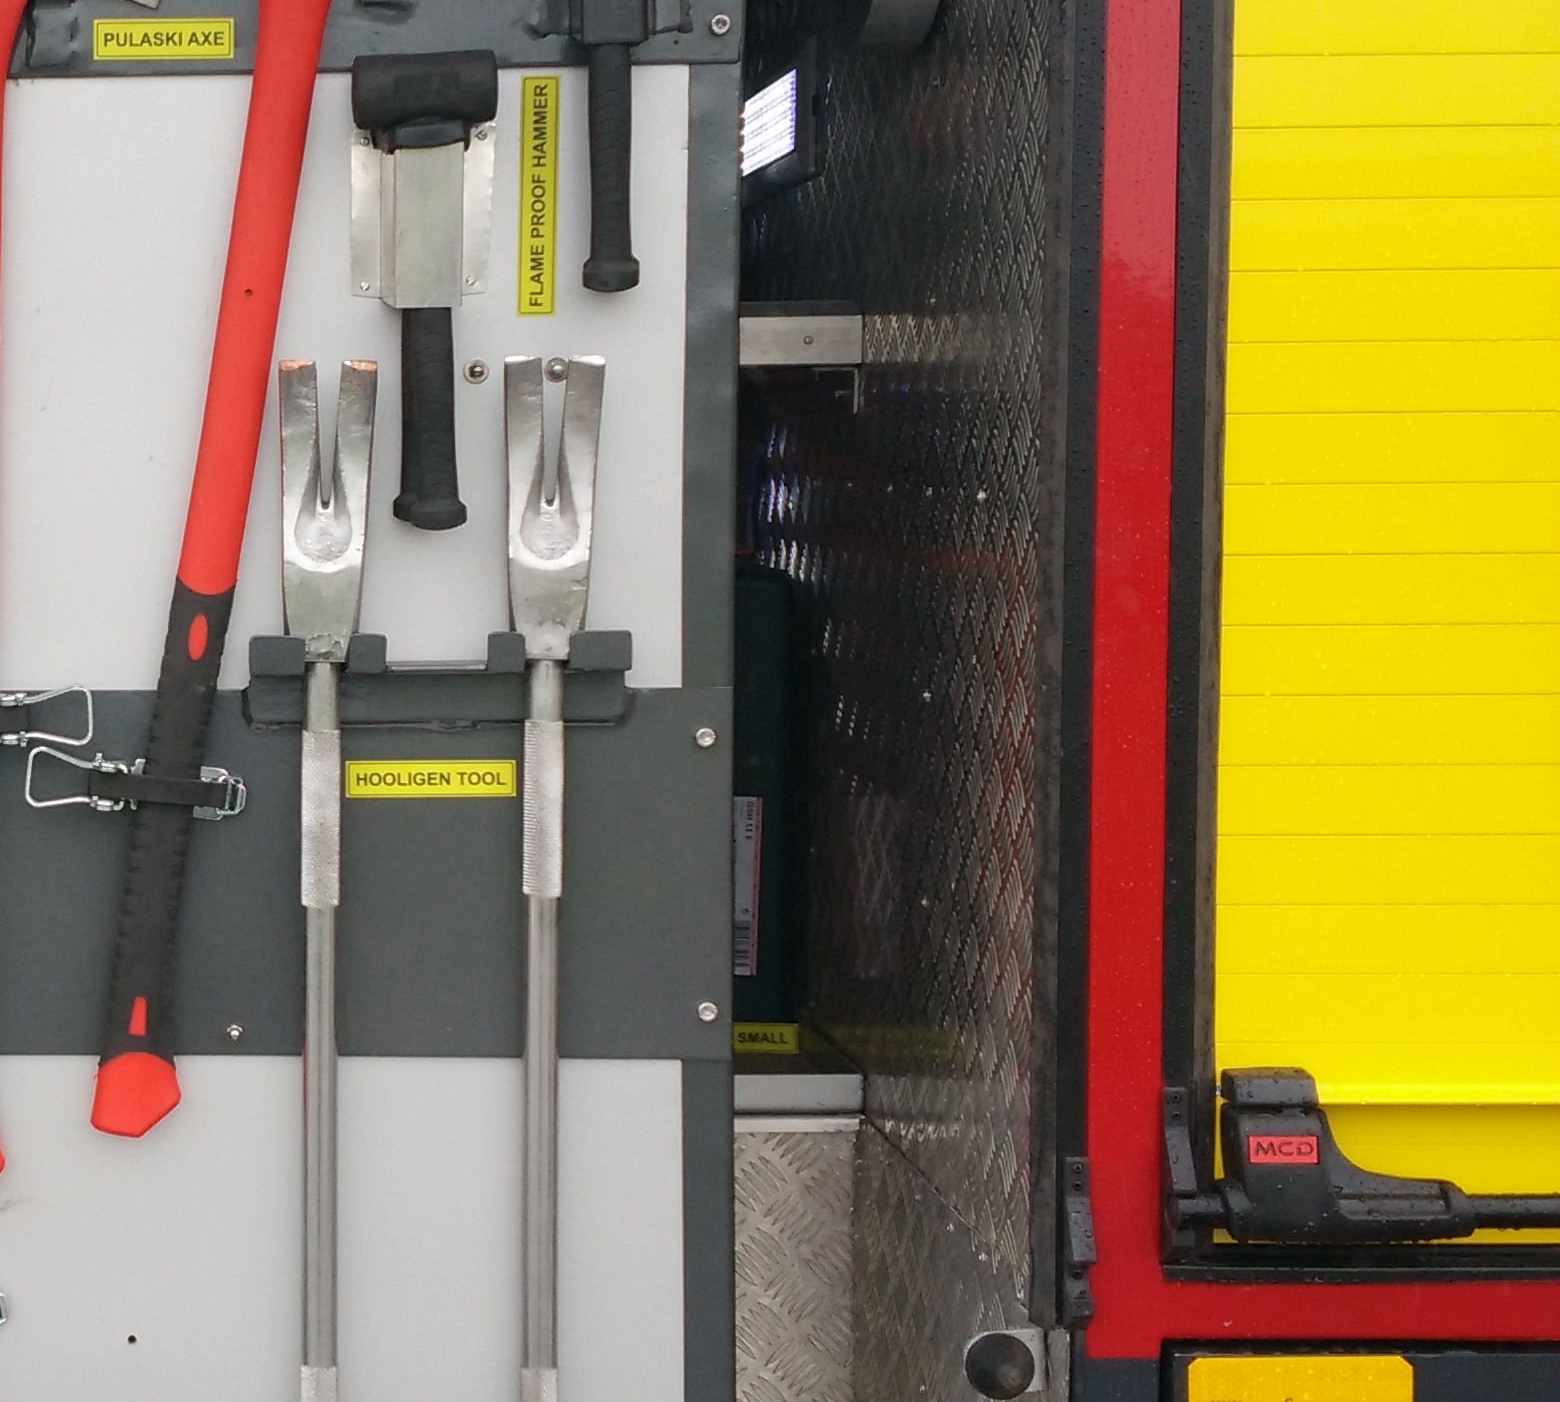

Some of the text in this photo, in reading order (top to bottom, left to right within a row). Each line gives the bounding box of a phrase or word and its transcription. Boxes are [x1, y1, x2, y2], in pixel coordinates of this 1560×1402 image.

[104, 31, 225, 47] PULASKI AXE
[529, 84, 548, 306] FLAME PROOF HAMMER
[356, 772, 507, 786] HOOLIGEN TOOL
[738, 1031, 789, 1045] SMALL
[1255, 1142, 1314, 1156] MCD
